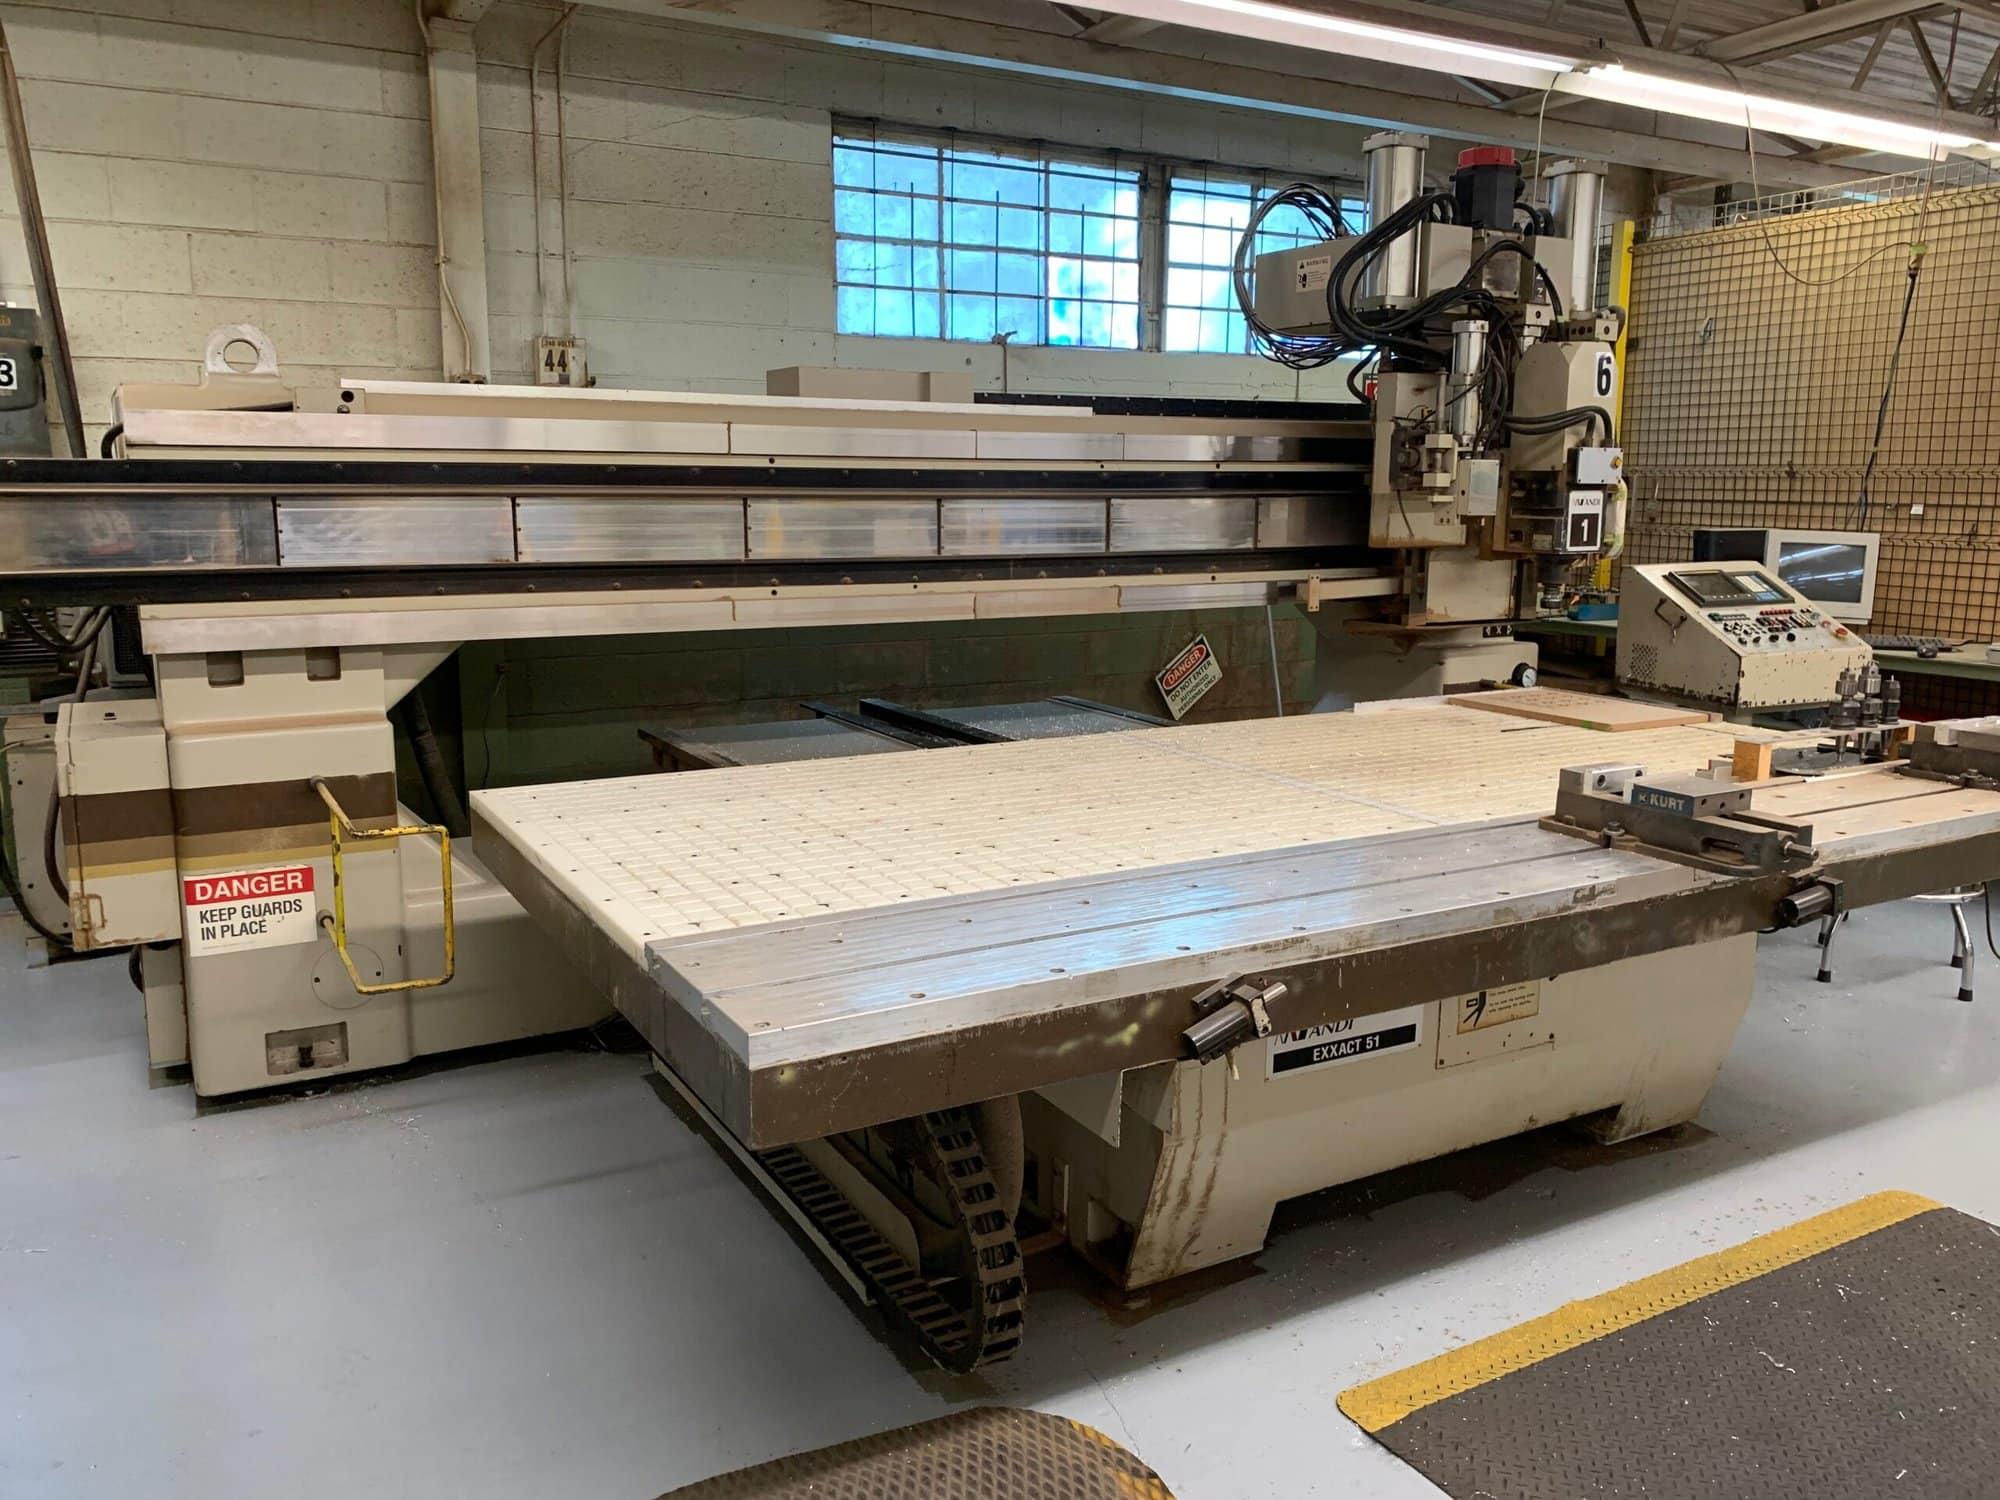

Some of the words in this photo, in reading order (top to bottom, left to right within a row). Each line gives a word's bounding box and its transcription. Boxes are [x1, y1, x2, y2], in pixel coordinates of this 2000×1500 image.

[0, 360, 14, 387] 3
[545, 349, 567, 372] 44
[1597, 354, 1612, 396] 6
[1581, 518, 1589, 542] 1
[1167, 649, 1201, 685] DANGER
[1170, 689, 1181, 702] DO
[1180, 677, 1193, 693] NOT
[1192, 660, 1213, 681] ENTER
[1178, 687, 1204, 714] PERSONNEL
[1203, 675, 1217, 689] ONLY
[1180, 673, 1210, 703] AUTHORIZED
[1650, 793, 1685, 811] KURT
[195, 872, 304, 901] DANGER
[200, 907, 238, 924] KEEP
[241, 899, 303, 919] GUARDS
[201, 927, 217, 940] IN
[220, 920, 268, 938] PLACE
[1313, 1040, 1363, 1062] EXXACT
[1366, 1035, 1380, 1049] 51
